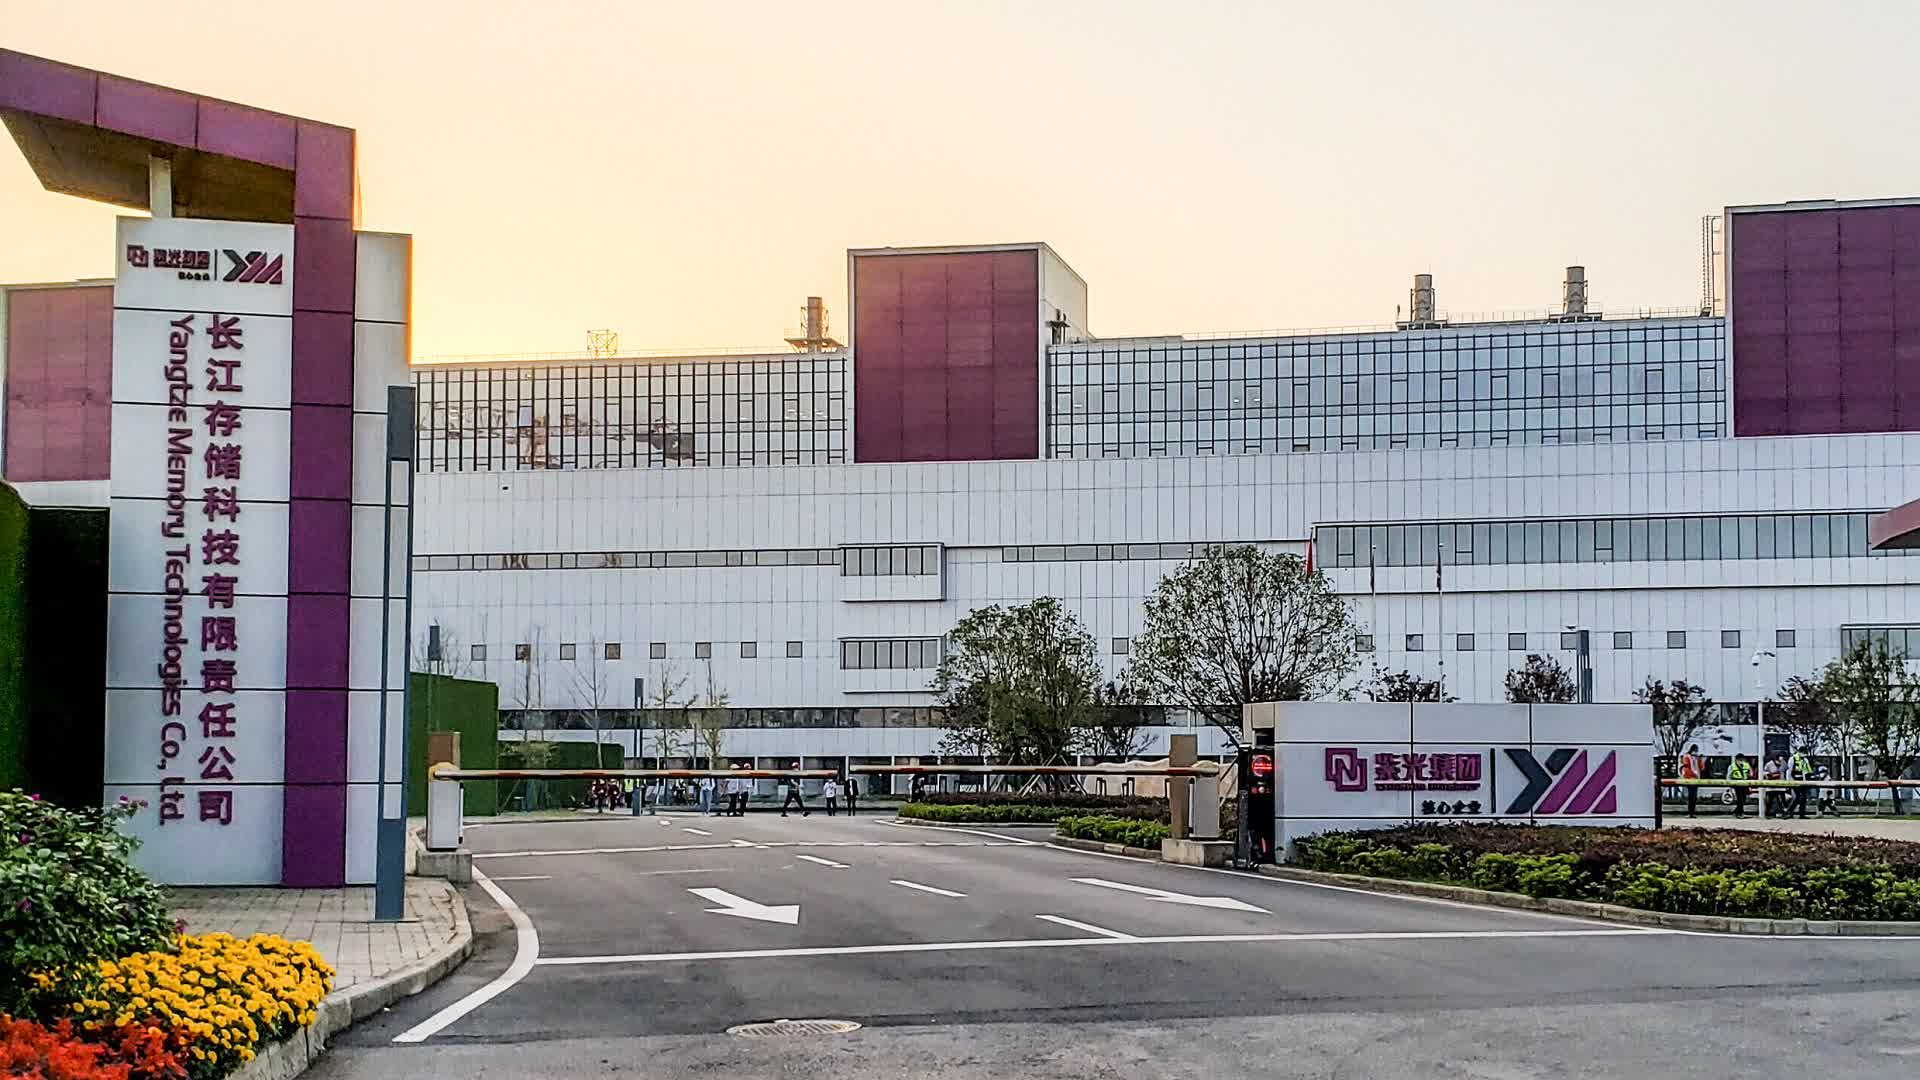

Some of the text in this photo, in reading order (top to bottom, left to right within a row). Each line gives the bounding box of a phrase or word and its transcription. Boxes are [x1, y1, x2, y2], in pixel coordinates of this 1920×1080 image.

[164, 314, 194, 423] Yangtze
[161, 428, 193, 538] Memory
[198, 314, 243, 826] 长江存储科技有限责任公司
[158, 544, 190, 716] Technologies
[1374, 753, 1481, 781] 紫光集团
